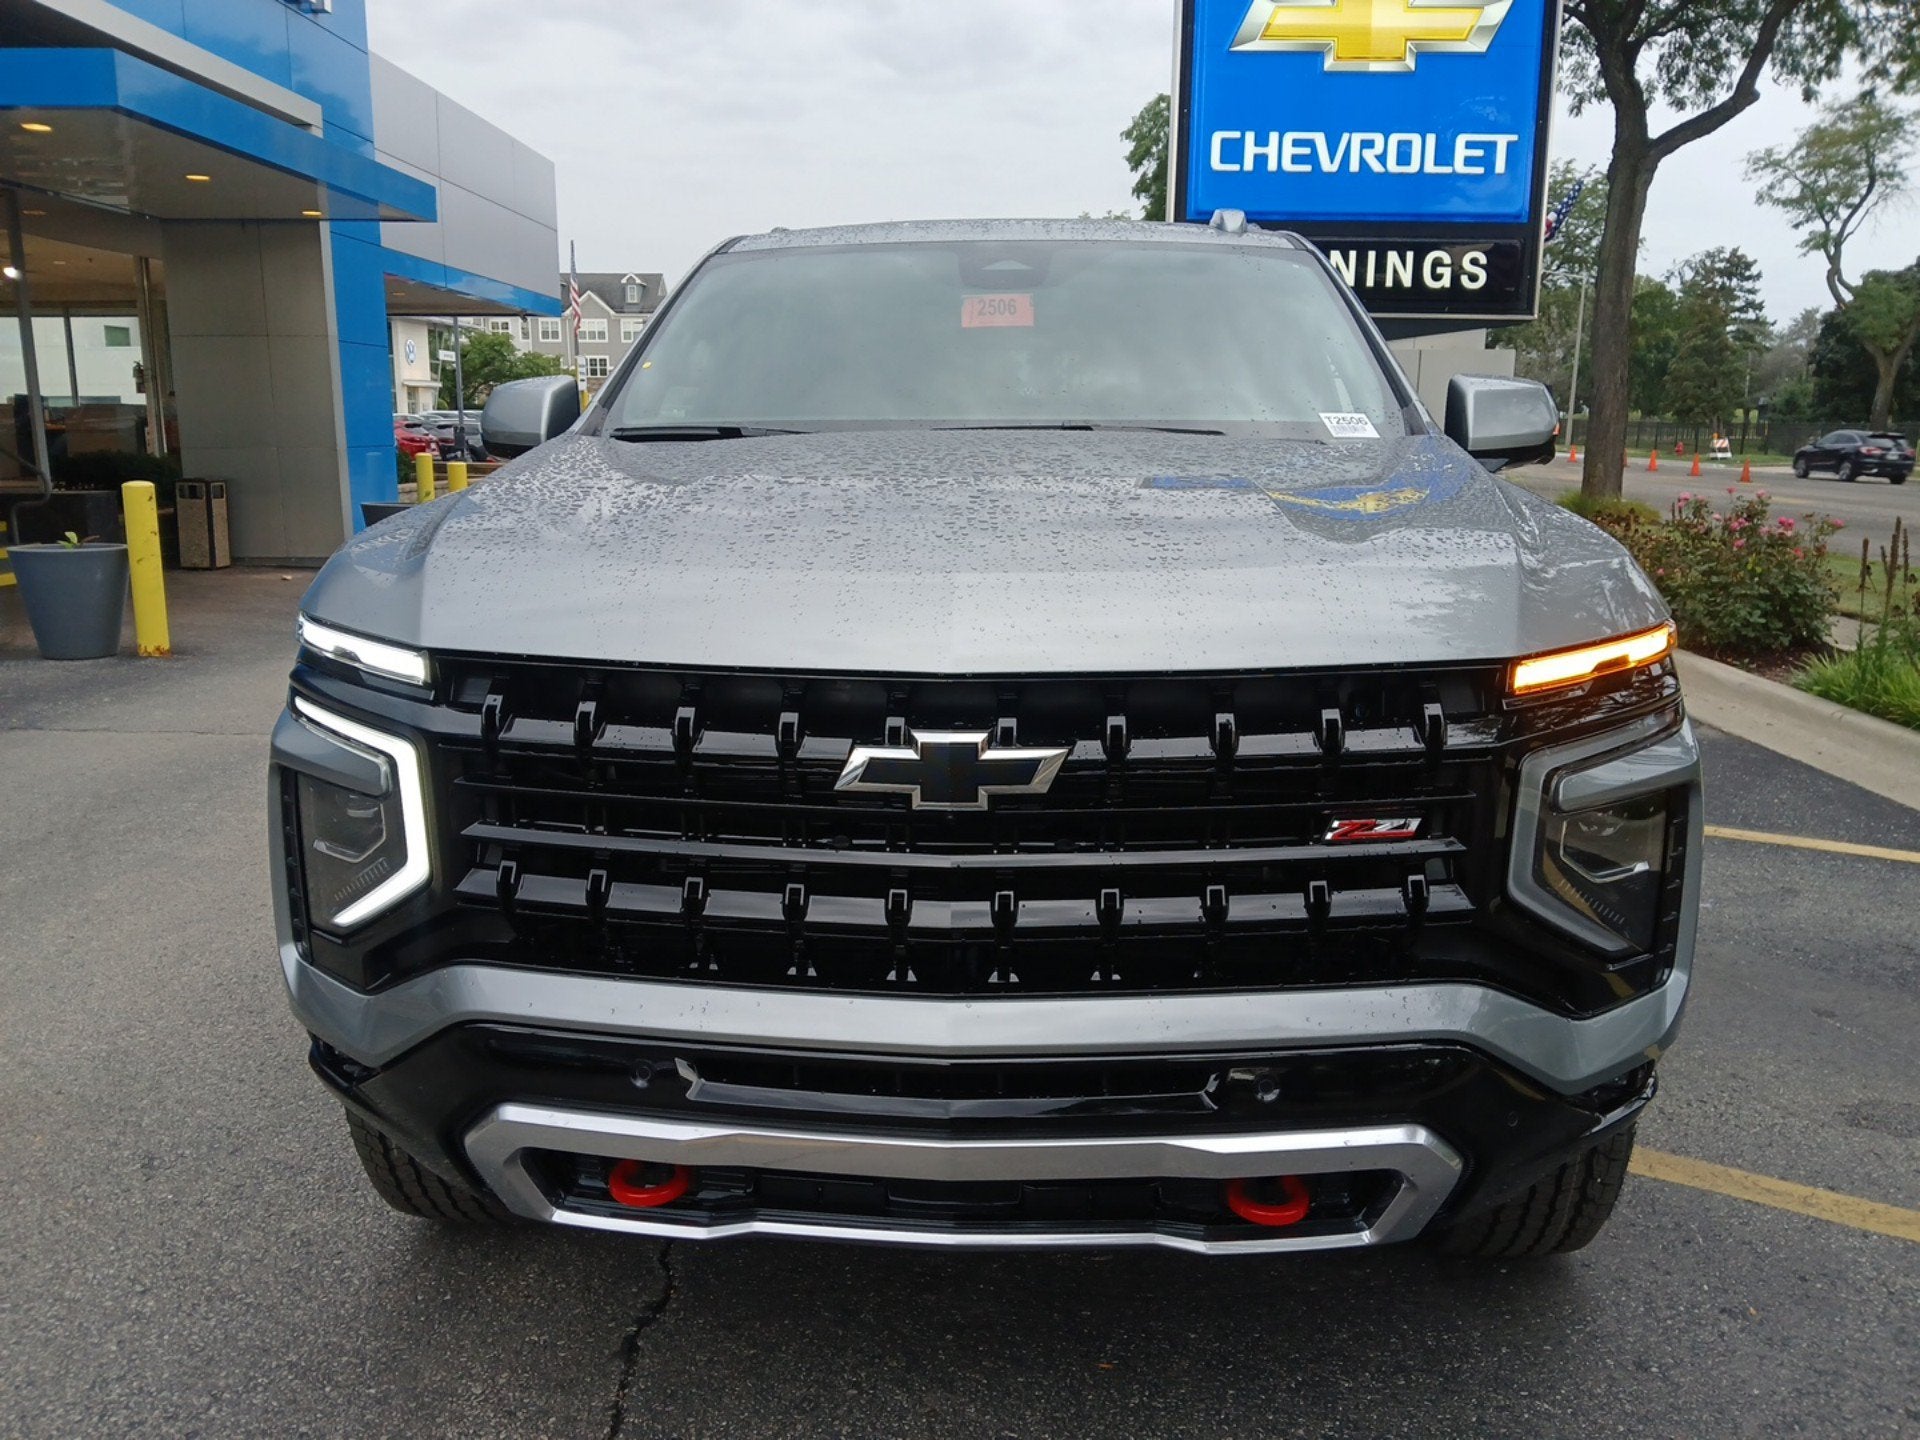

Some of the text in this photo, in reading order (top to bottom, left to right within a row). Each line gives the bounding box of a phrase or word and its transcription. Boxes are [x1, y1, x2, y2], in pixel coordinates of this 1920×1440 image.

[1210, 130, 1519, 175] CHEVROLET
[1330, 249, 1488, 290] NINGS
[977, 298, 1018, 317] 2506
